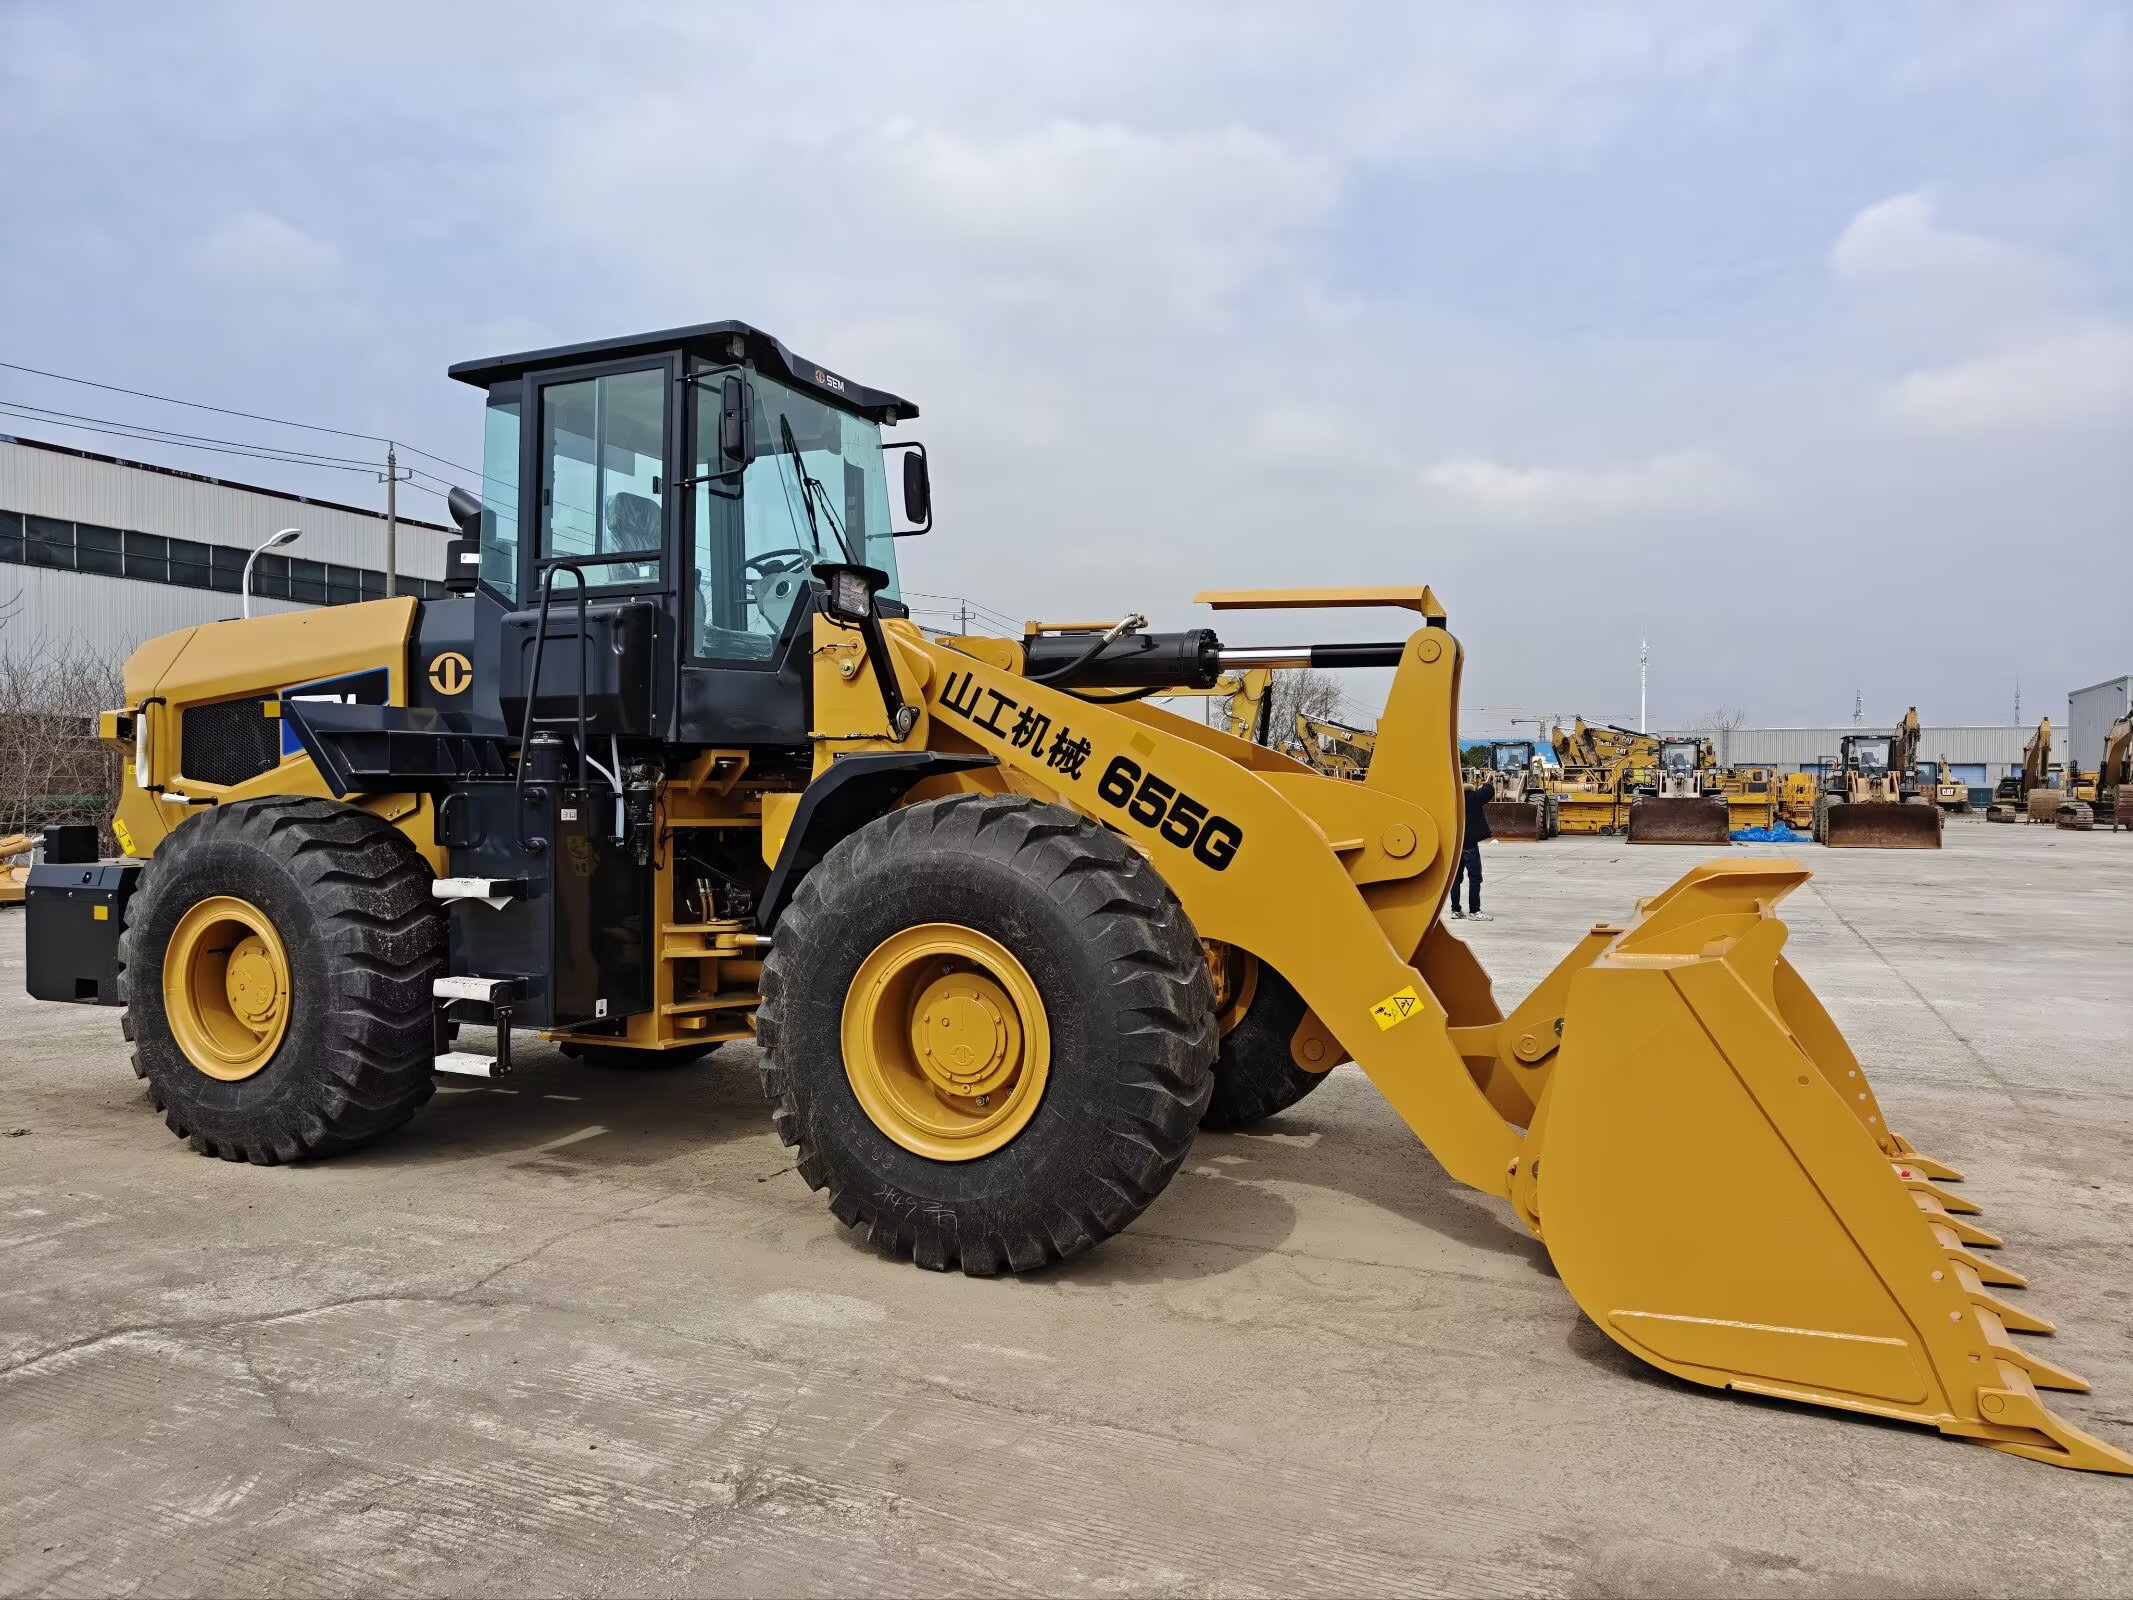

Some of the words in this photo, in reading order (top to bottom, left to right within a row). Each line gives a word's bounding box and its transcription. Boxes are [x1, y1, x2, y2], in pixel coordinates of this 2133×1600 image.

[826, 375, 845, 392] SEM
[938, 671, 1092, 781] 山工机械
[1097, 755, 1244, 872] 655G
